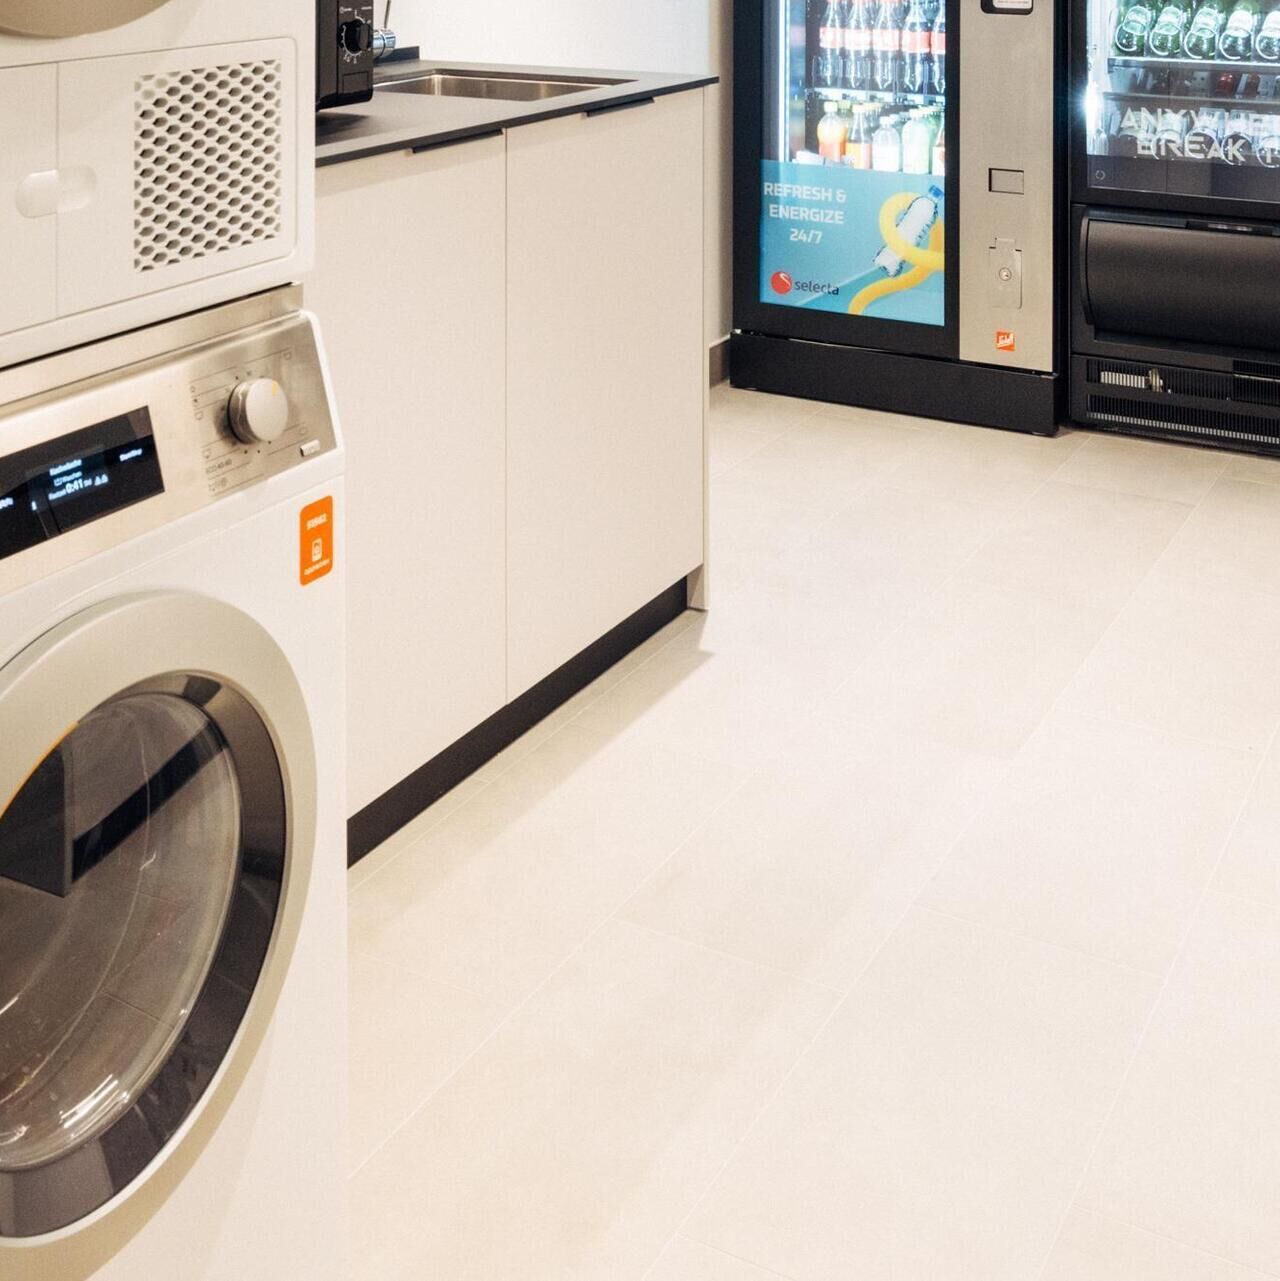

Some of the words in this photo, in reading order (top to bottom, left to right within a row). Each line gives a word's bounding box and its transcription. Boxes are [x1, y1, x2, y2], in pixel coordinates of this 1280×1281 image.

[1137, 134, 1247, 163] BREAK
[763, 182, 833, 202] REFRESH
[836, 189, 847, 203] &
[768, 204, 845, 224] ENERGIZE
[789, 228, 823, 244] 24/7
[794, 280, 840, 296] selecta
